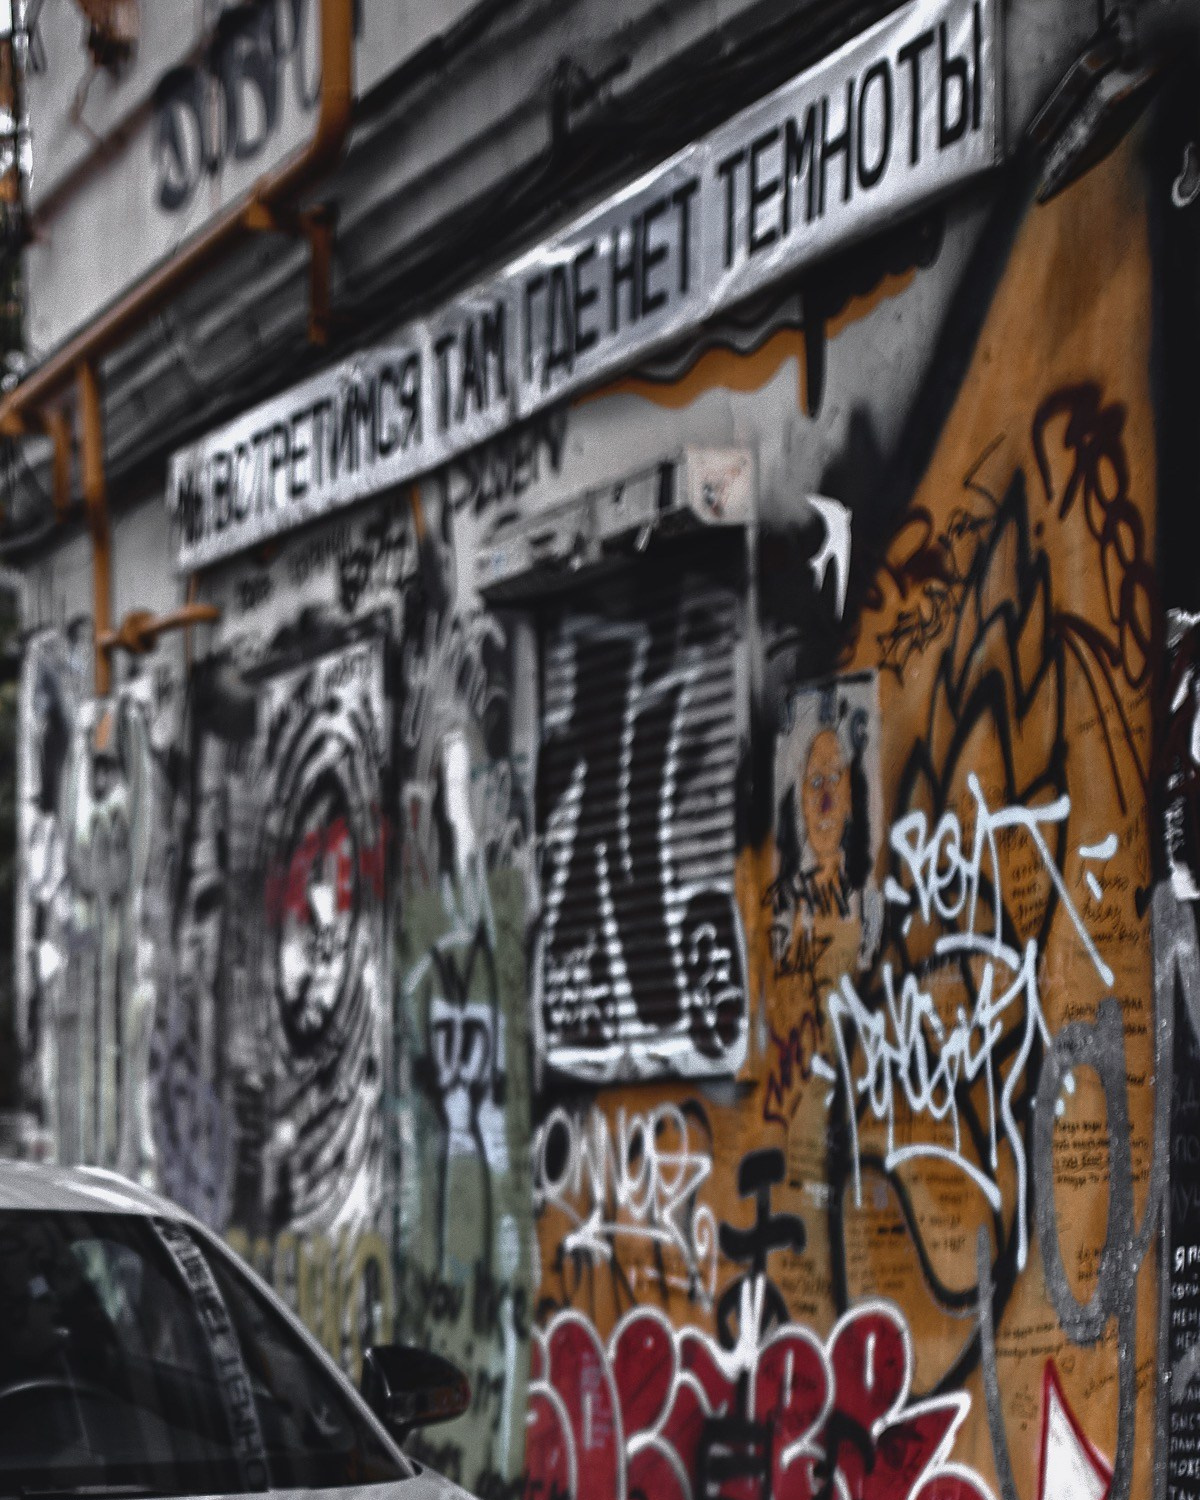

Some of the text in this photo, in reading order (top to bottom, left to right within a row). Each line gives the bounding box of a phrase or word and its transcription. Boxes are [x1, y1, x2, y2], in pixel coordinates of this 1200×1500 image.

[212, 353, 422, 532] ВСТРЕТИМСЯ
[435, 302, 507, 434] ТАМ
[524, 245, 598, 386] ГДЕ
[608, 178, 697, 334] НЕТ
[717, 3, 981, 269] ТЕМНОТЫ
